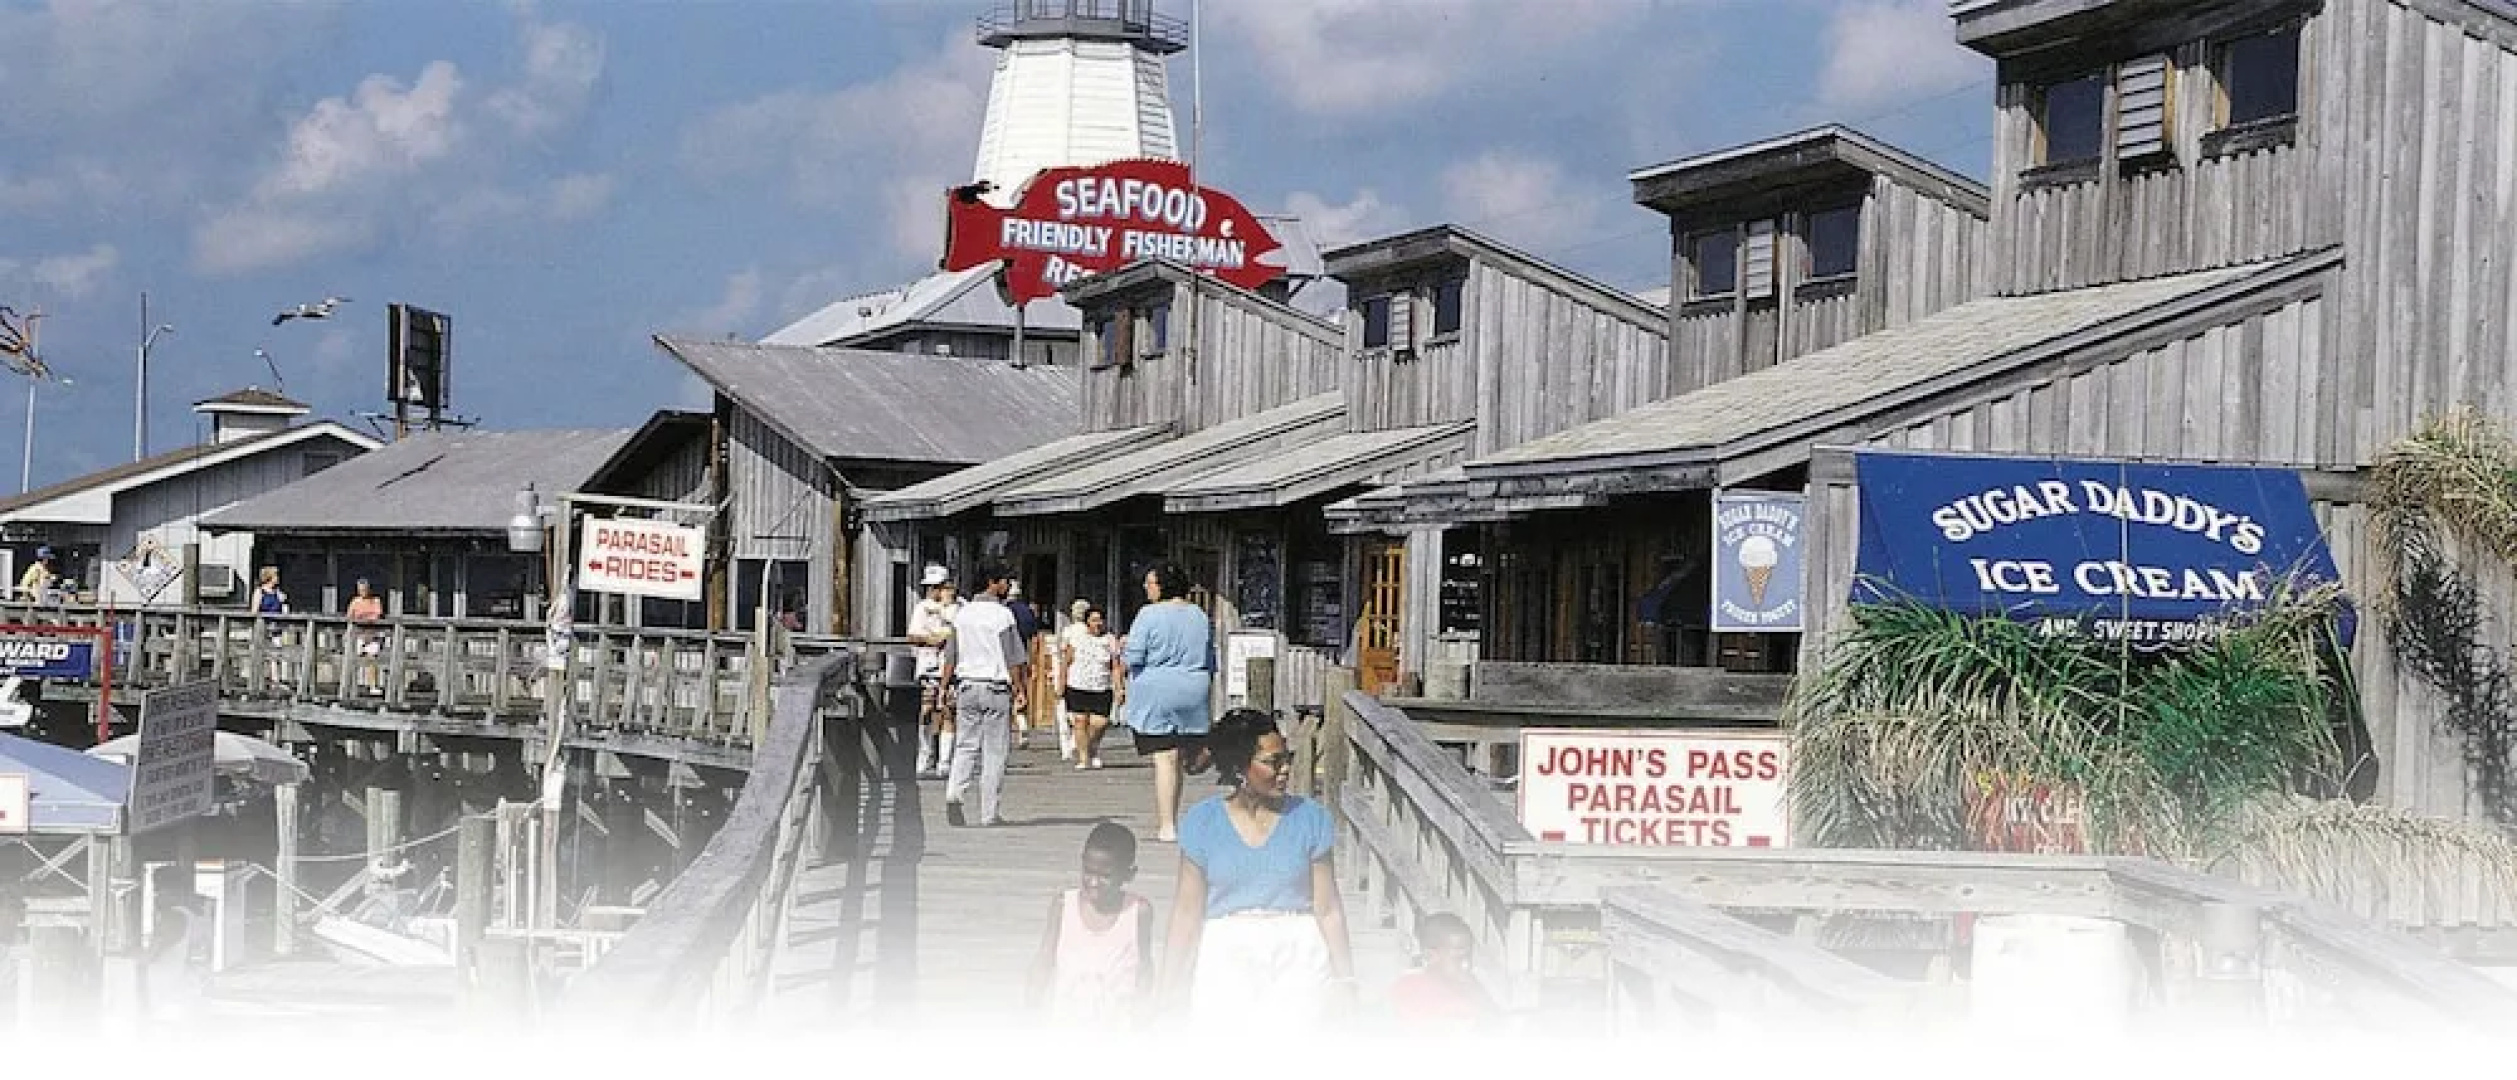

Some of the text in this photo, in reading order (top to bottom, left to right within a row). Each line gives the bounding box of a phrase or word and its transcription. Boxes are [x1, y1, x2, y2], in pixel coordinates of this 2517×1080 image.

[1056, 177, 1207, 230] SEAFOOD
[1002, 218, 1246, 266] FRIENDLY FISHERMAN
[1932, 480, 2266, 555] SUGAR DADDY'S
[596, 528, 690, 557] PARASAIL
[605, 556, 678, 582] RIDES
[1970, 558, 2267, 601] ICE CREAM
[2094, 620, 2158, 641] SWEET
[1537, 747, 1779, 780] JOHN'S PASS
[1567, 782, 1742, 815] PARASAIL
[1581, 817, 1732, 848] TICKETS
